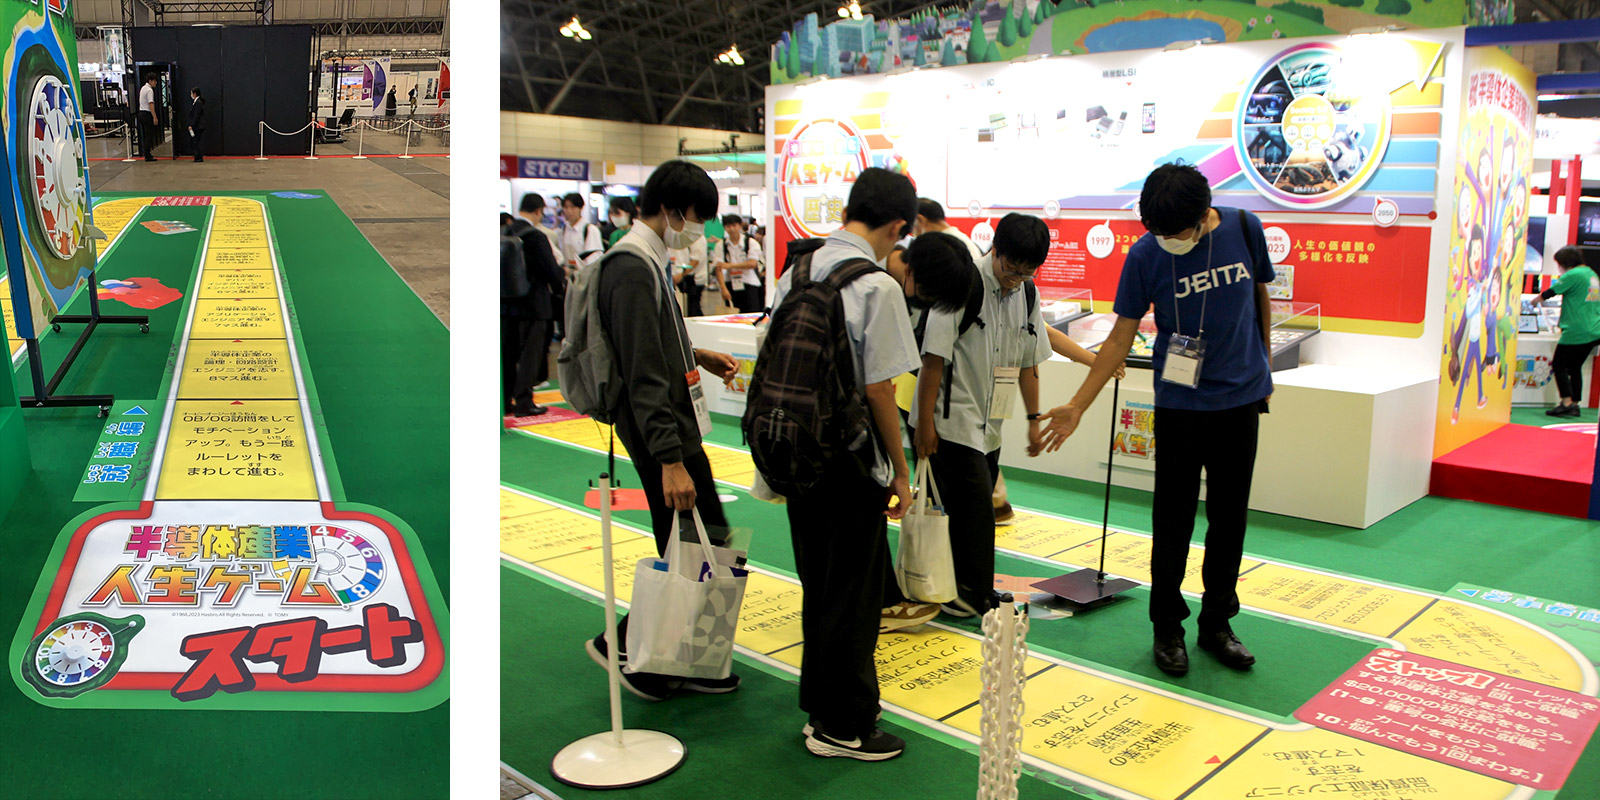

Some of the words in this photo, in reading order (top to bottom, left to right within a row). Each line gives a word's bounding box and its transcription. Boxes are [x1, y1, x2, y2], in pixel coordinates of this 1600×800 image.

[1377, 209, 1394, 217] 2050
[974, 232, 991, 242] 1968
[1091, 236, 1111, 246] 1997
[1115, 234, 1143, 243] 2つの
[1267, 243, 1285, 253] 023
[1293, 239, 1376, 252] 人生の価値観の
[1299, 251, 1370, 264] 多様化を反映
[1175, 262, 1251, 298] JEITA
[183, 415, 295, 423] OB/OG訪問をして
[196, 452, 282, 461] ルーレットを
[1113, 432, 1155, 459] 人生
[187, 467, 285, 477] まわして進む。
[125, 525, 316, 561] 半導体産業
[80, 563, 347, 608] 人生ゲーム
[171, 603, 423, 702] スタート
[876, 646, 966, 684] ソフトウェア開
[1365, 656, 1496, 689] ストップ!
[1025, 694, 1095, 728] 2マス進む。
[1343, 680, 1572, 745] $20,000の初任給をもらう。
[1358, 671, 1559, 727] する半導体企業を決める。
[1496, 681, 1599, 711] ルーレットを
[1034, 694, 1139, 749] エンジニアを志す。
[1087, 717, 1143, 750] 生産技術
[1373, 715, 1506, 756] カードをもらう。
[1109, 721, 1186, 767] 半導体企業の
